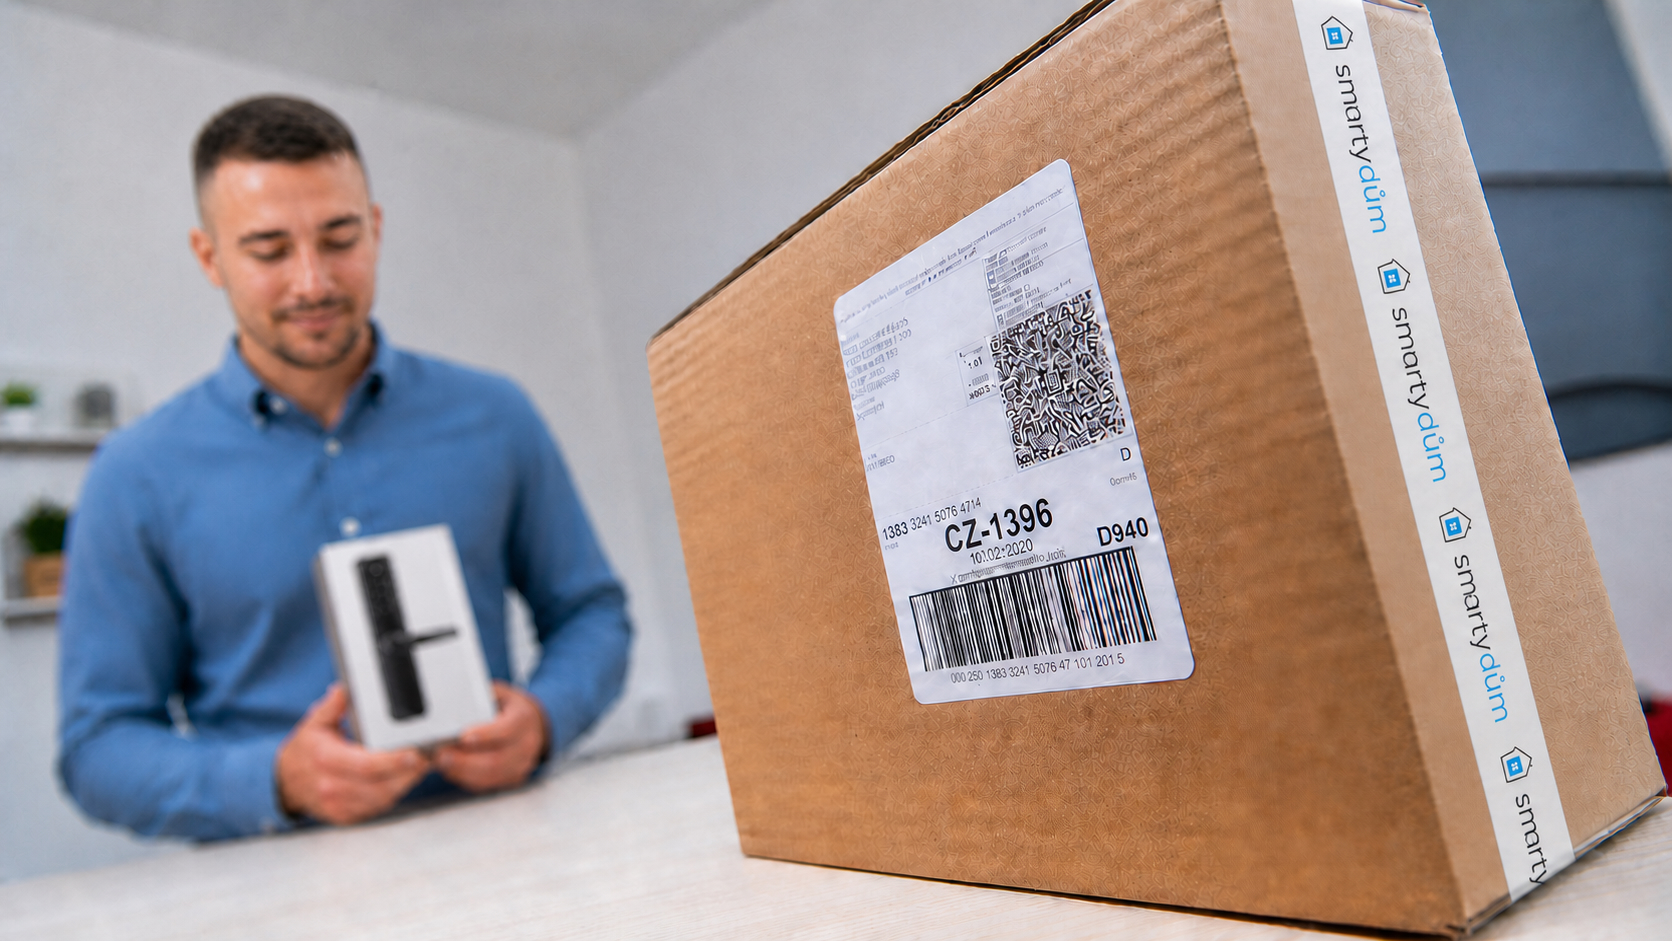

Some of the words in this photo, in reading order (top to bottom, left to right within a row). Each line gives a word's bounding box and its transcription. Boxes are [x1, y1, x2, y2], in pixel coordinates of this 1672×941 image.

[1335, 64, 1387, 234] smartydům
[1392, 307, 1447, 483] smartydům
[1120, 447, 1132, 461] D
[882, 521, 908, 540] 1383
[910, 514, 932, 531] 3241
[934, 505, 958, 523] 5076
[960, 497, 982, 514] 4714
[945, 498, 1053, 552] CZ-1396
[1096, 517, 1149, 547] D940
[1454, 554, 1508, 723] smartydům
[951, 671, 966, 683] 000
[968, 670, 983, 682] 250
[986, 667, 1007, 680] 1383
[1009, 665, 1030, 678] 3241
[1033, 661, 1057, 675] 5076
[1059, 658, 1071, 671] 47
[1074, 656, 1092, 669] 101
[1515, 793, 1547, 885] smarty
